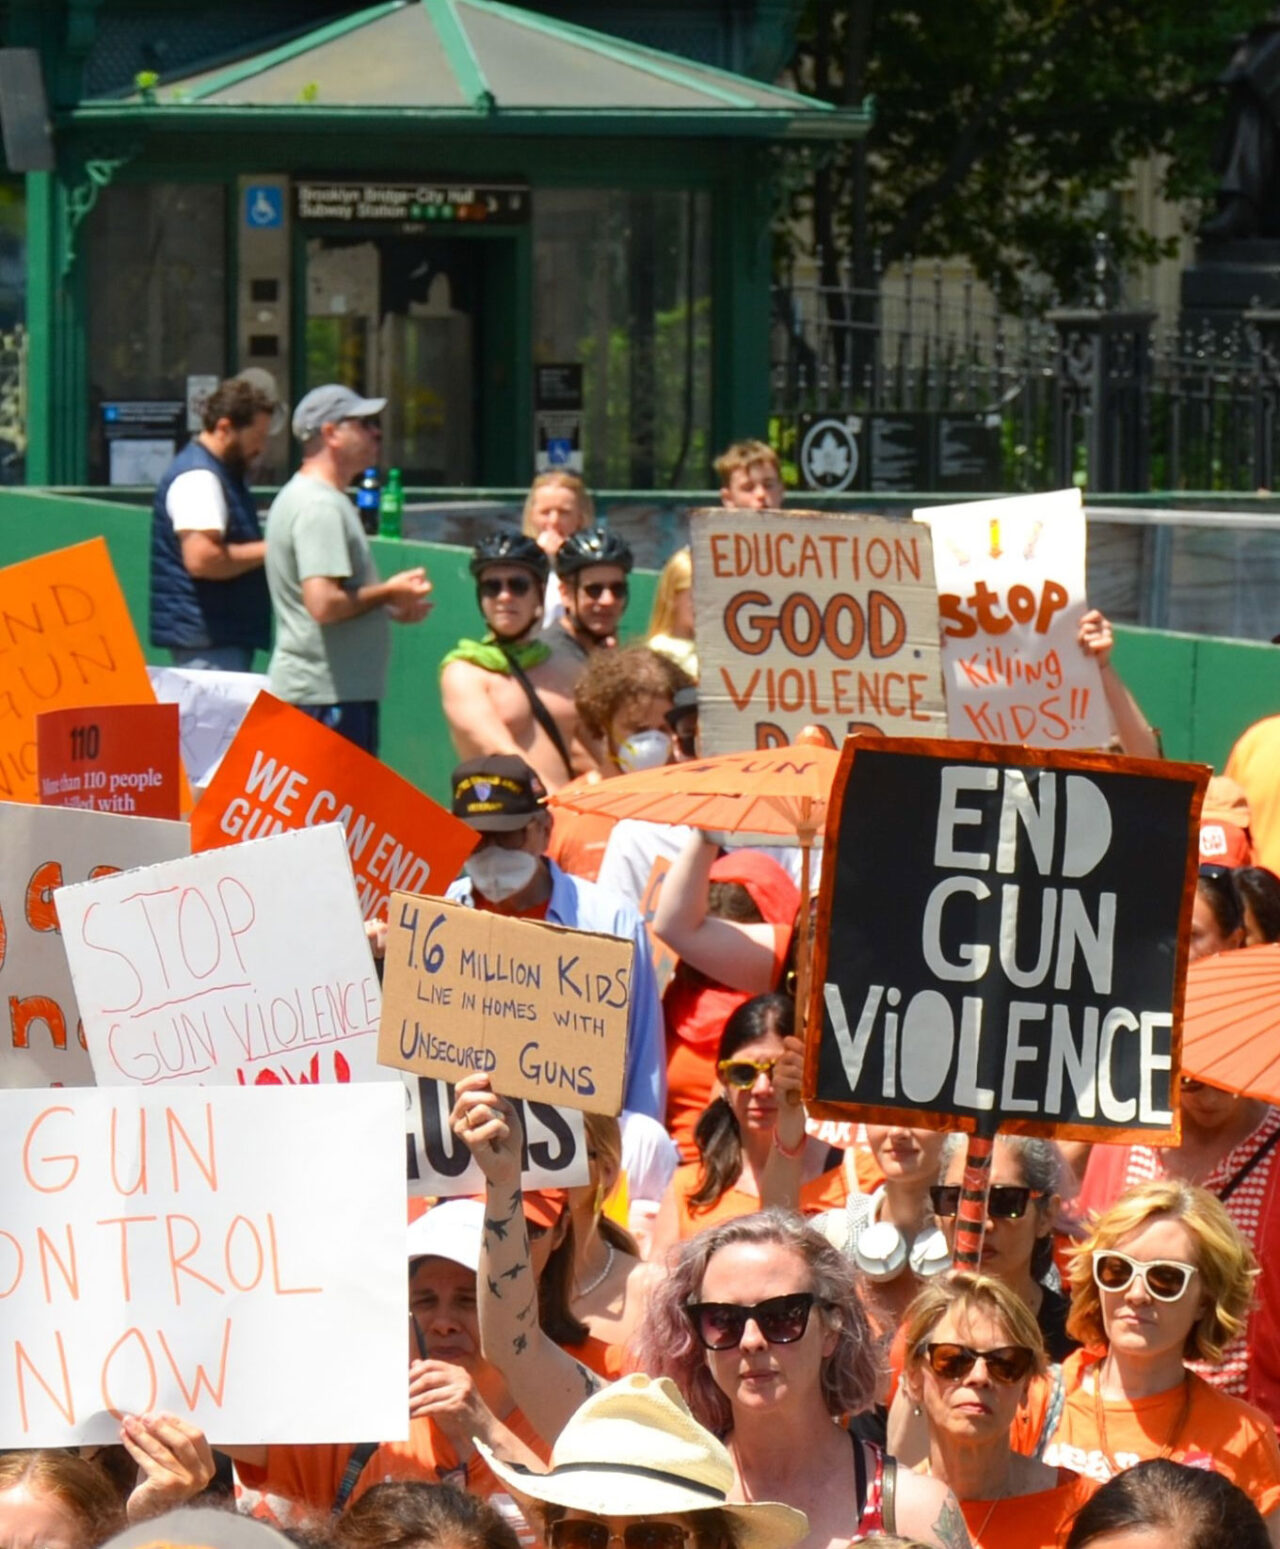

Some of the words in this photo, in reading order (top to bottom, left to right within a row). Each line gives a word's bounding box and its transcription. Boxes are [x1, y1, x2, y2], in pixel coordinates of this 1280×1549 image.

[710, 532, 922, 582] EDUCATION
[720, 666, 932, 722] VIOLENCE
[70, 724, 100, 761] 110
[84, 772, 107, 789] 110
[110, 768, 163, 792] people
[98, 793, 136, 812] with
[244, 750, 309, 817] WE
[305, 790, 376, 861] CAN
[366, 832, 431, 895] END
[932, 765, 1114, 878] END
[81, 876, 256, 1014] STOP
[921, 876, 1118, 995] GUN
[416, 980, 453, 1007] LIVE
[462, 991, 476, 1011] IN
[482, 996, 538, 1021] HOMES
[554, 1011, 605, 1038] WITH
[460, 948, 541, 990] MILLION
[557, 954, 629, 1010] KIDS
[108, 1011, 218, 1081] GUN
[223, 977, 382, 1063] VIOLENCE
[400, 1018, 497, 1073] UNSECURED
[519, 1041, 596, 1096] GUNS
[22, 1101, 219, 1196] GUN
[13, 1317, 233, 1433] NOW
